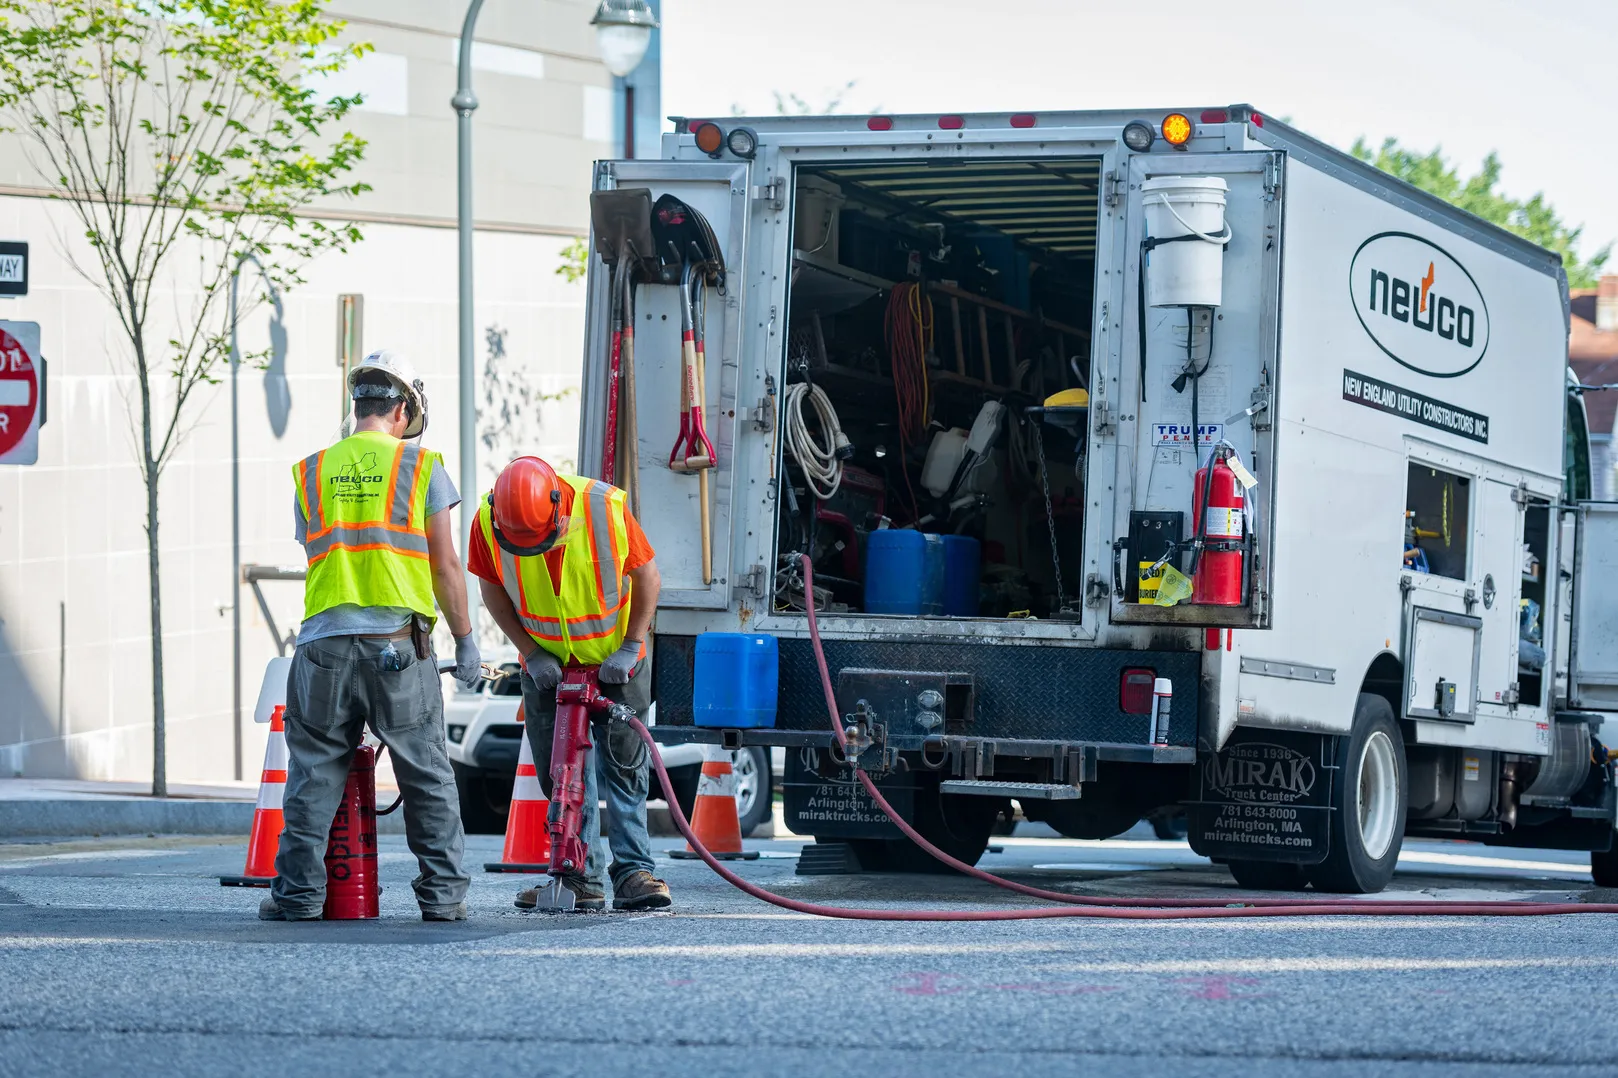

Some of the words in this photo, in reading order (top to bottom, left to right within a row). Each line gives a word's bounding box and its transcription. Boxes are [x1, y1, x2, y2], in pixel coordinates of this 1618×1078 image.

[1344, 376, 1362, 397] NEW
[1363, 382, 1396, 408] ENGLAND
[1398, 393, 1422, 417] UTILITY
[1423, 402, 1474, 434] CONSTRUCTORS
[1474, 418, 1488, 439] INC.
[1158, 426, 1217, 435] TRUMP
[1229, 746, 1258, 758] Since
[1263, 748, 1292, 760] 1936
[1209, 754, 1310, 797] MIRAK
[1224, 787, 1256, 800] Truck
[1260, 789, 1295, 802] Center
[808, 796, 868, 811] Arlington,
[1222, 805, 1241, 816] 781
[1245, 806, 1297, 819] 643-8000
[1214, 817, 1279, 833] Arlington,
[1281, 821, 1303, 833] MA
[1204, 830, 1313, 847] miraktrucks.com
